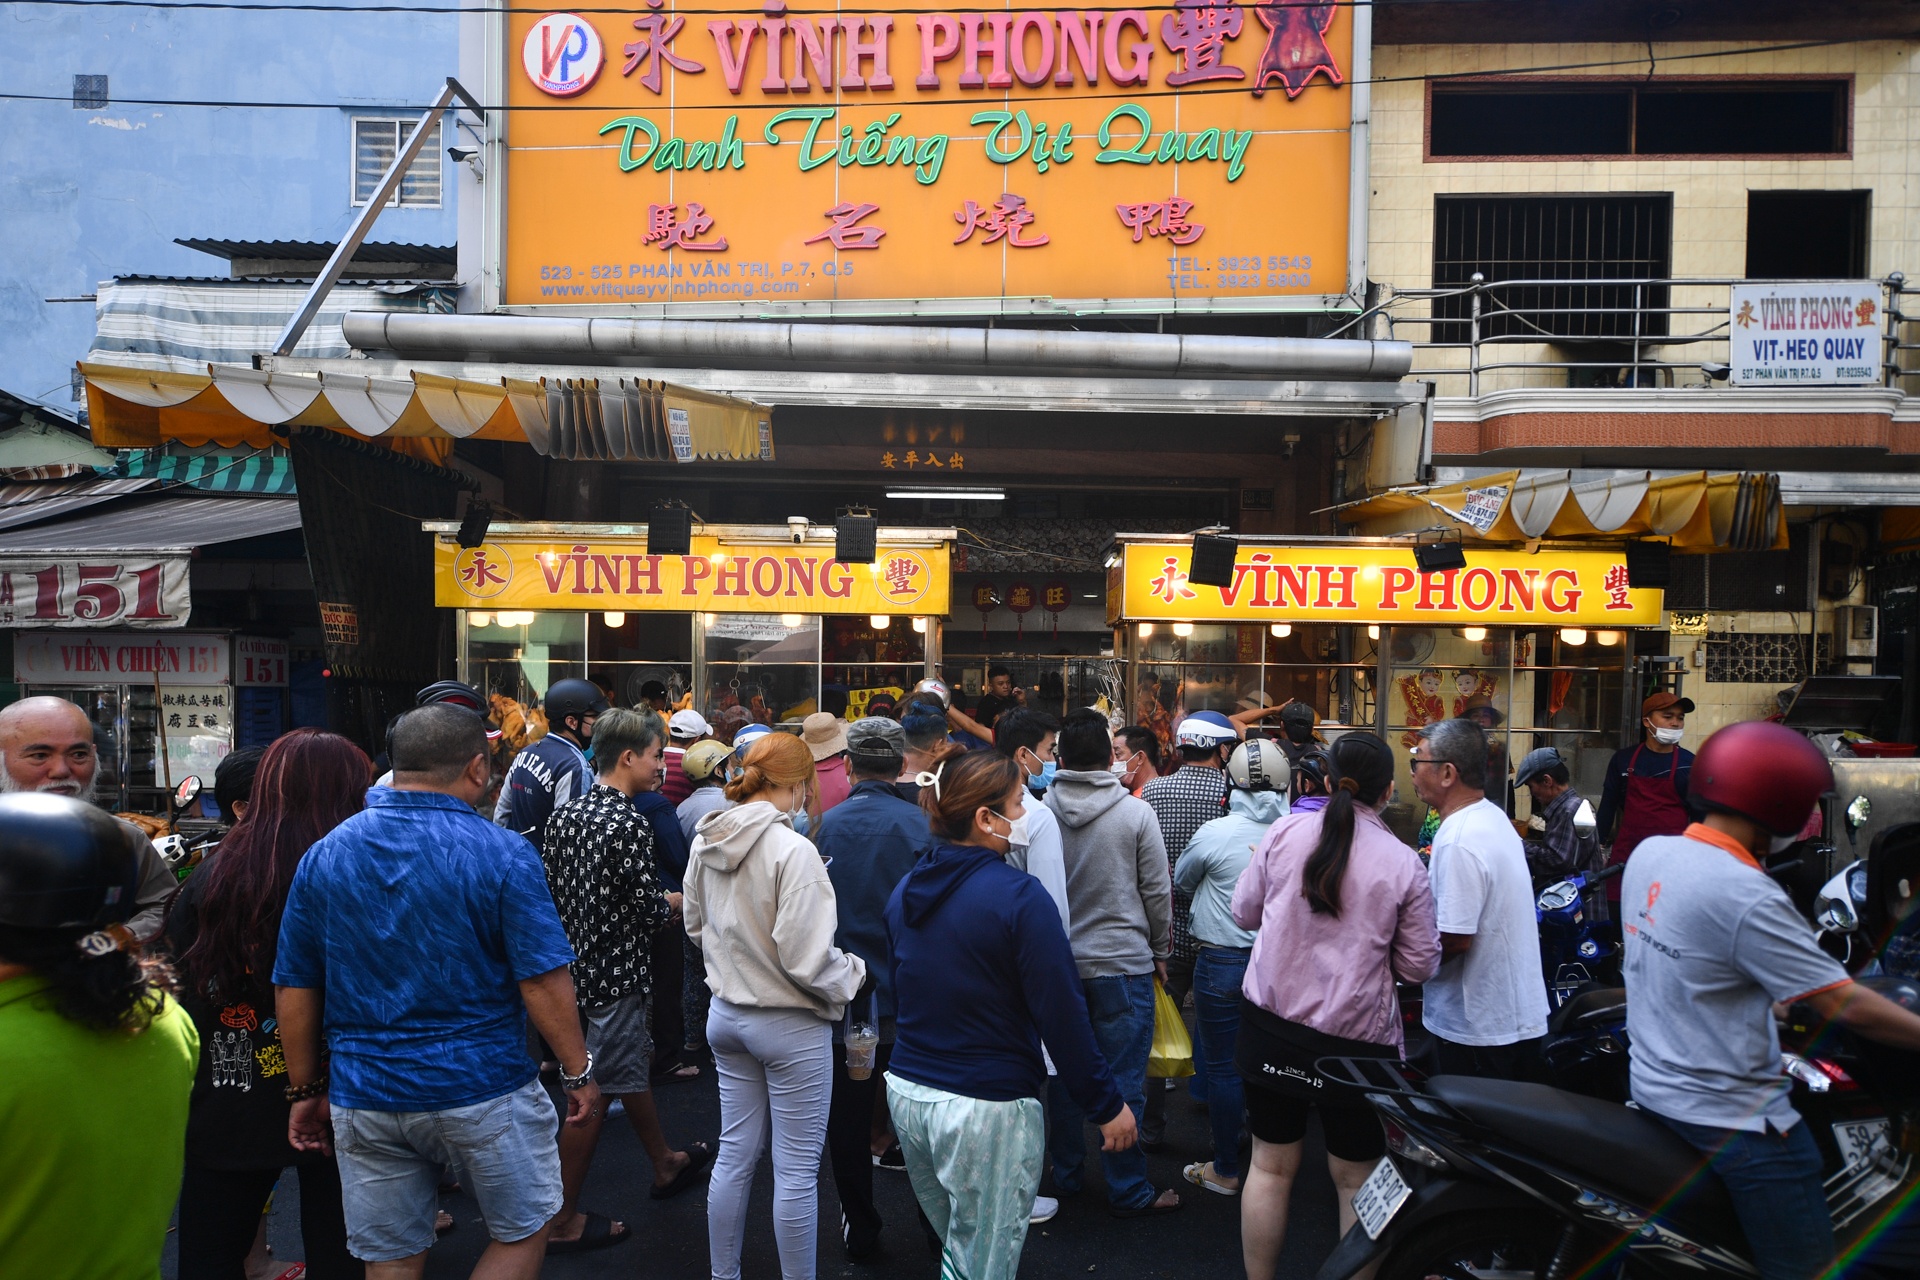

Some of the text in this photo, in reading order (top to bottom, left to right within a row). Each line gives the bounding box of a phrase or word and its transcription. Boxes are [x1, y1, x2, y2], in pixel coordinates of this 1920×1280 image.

[915, 8, 1154, 90] PHONG
[599, 103, 1253, 185] Danh Tiếng Vịt Quay
[540, 265, 573, 281] 523
[590, 263, 622, 280] 525
[629, 263, 683, 278] PHAN
[689, 259, 731, 277] VĂN
[821, 260, 854, 277] Q.5
[1217, 256, 1261, 271] 3923
[1267, 255, 1312, 271] 5543
[540, 279, 799, 299] www.vitquayvnhphong.com
[1216, 273, 1261, 288] 3923
[1267, 273, 1311, 288] 5800
[1800, 296, 1853, 330] PHONG
[1823, 338, 1865, 361] QUAY
[1742, 368, 1753, 379] 527
[1755, 368, 1772, 379] PHAN
[459, 550, 506, 588] 永
[534, 545, 854, 599] VĨNH PHONG
[1151, 557, 1196, 603] 永
[1217, 553, 1582, 614] VĨNH PHONG
[25, 563, 178, 621] 151
[61, 638, 110, 673] VIÊN
[116, 639, 180, 673] CHIÊN
[188, 646, 219, 673] 151
[244, 656, 286, 684] 151
[1262, 1063, 1324, 1088] 20 SINCE 15
